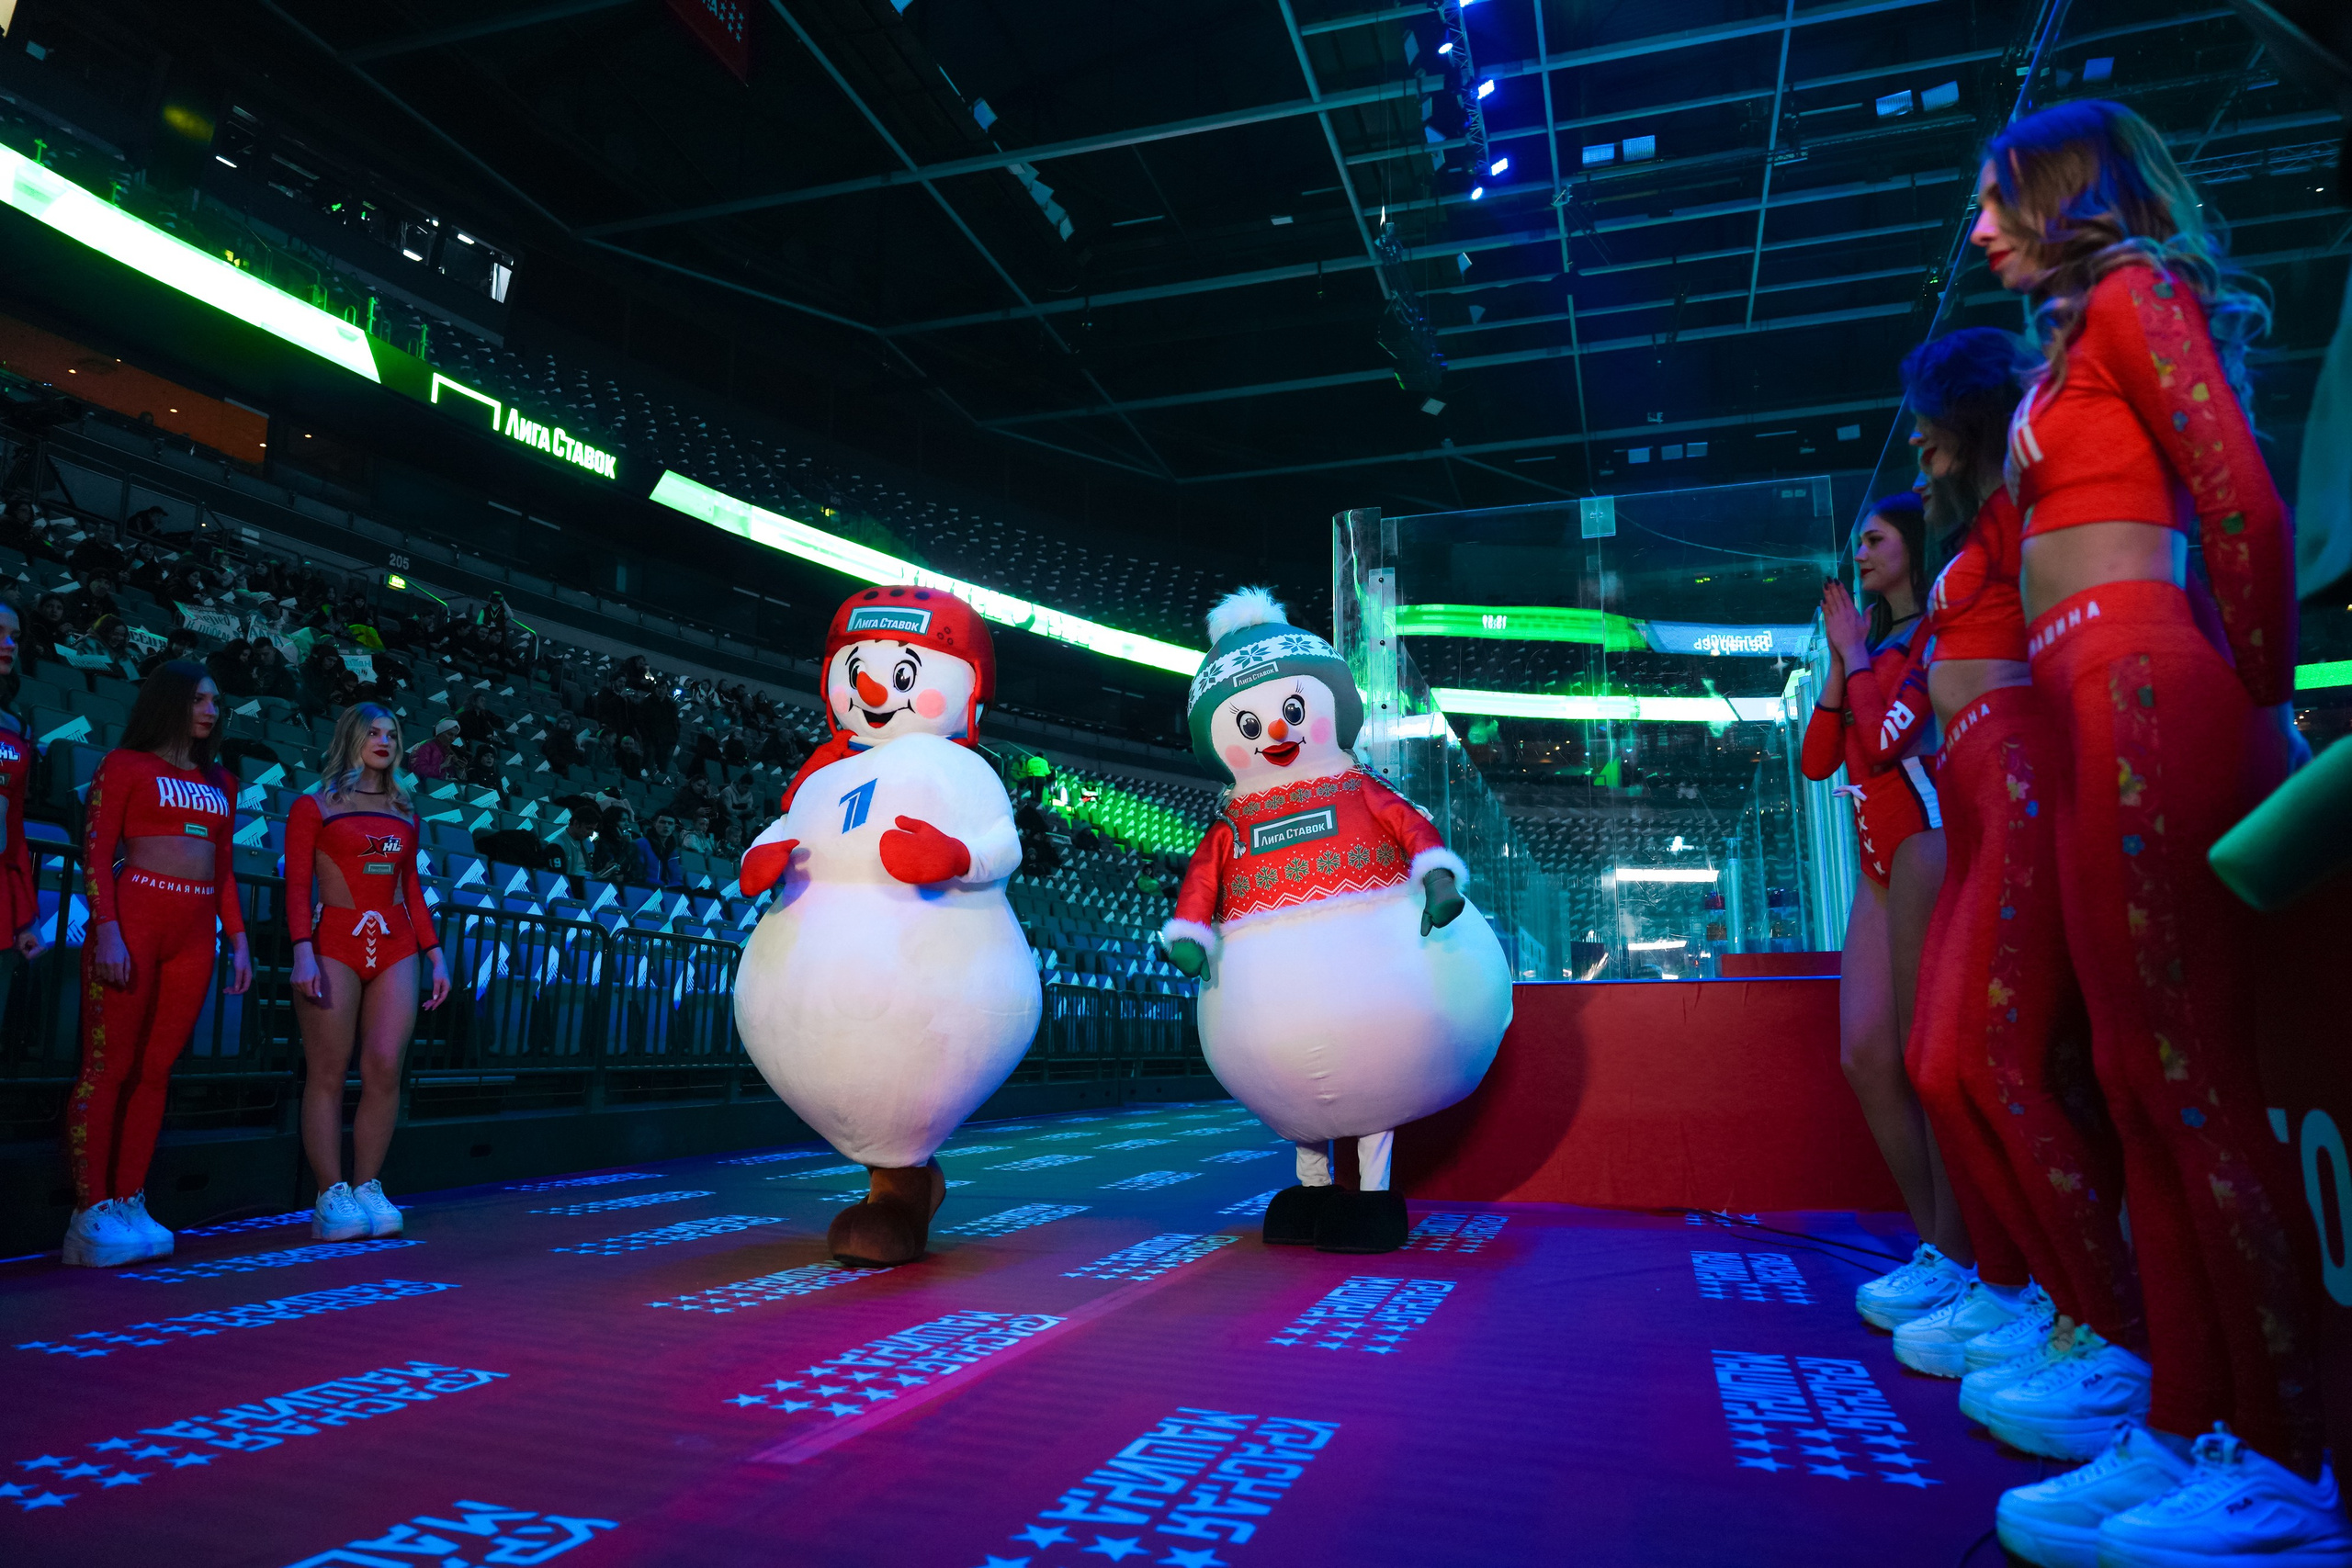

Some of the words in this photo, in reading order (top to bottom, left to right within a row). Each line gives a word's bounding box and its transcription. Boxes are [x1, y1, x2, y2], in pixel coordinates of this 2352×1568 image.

[389, 552, 410, 570] 205
[1300, 1275, 1404, 1319] МАШИНА
[1371, 1278, 1458, 1325] КРАСНАЯ
[822, 1309, 1014, 1368] МАШИНА
[896, 1314, 1069, 1376] КРАСНАЯ
[138, 1359, 458, 1441] МАШИНА
[205, 1369, 511, 1453] КРАСНАЯ
[1710, 1348, 1815, 1425] МАШИНА
[1794, 1356, 1908, 1434] КРАСНАЯ
[1036, 1405, 1259, 1527] МАШИНА
[1155, 1416, 1341, 1545] КРАСНАЯ
